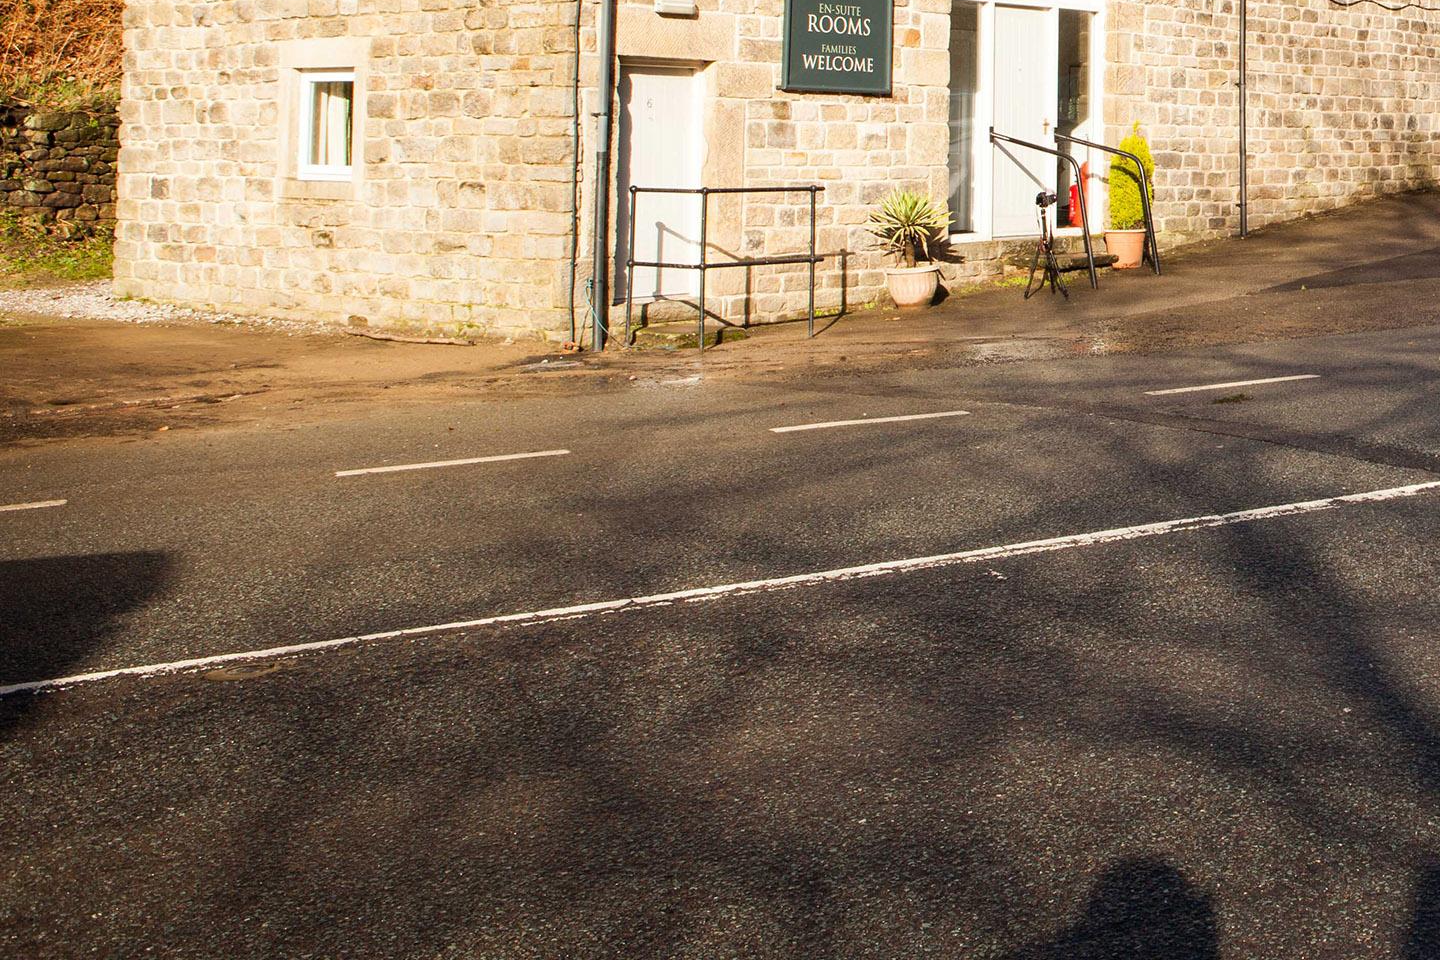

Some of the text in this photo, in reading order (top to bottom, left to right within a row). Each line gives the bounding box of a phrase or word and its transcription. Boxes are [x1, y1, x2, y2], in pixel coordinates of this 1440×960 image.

[819, 2, 862, 17] EN-SUITE
[806, 13, 872, 37] ROOMS
[821, 43, 857, 56] FAMILIES
[802, 53, 875, 73] WELCOME
